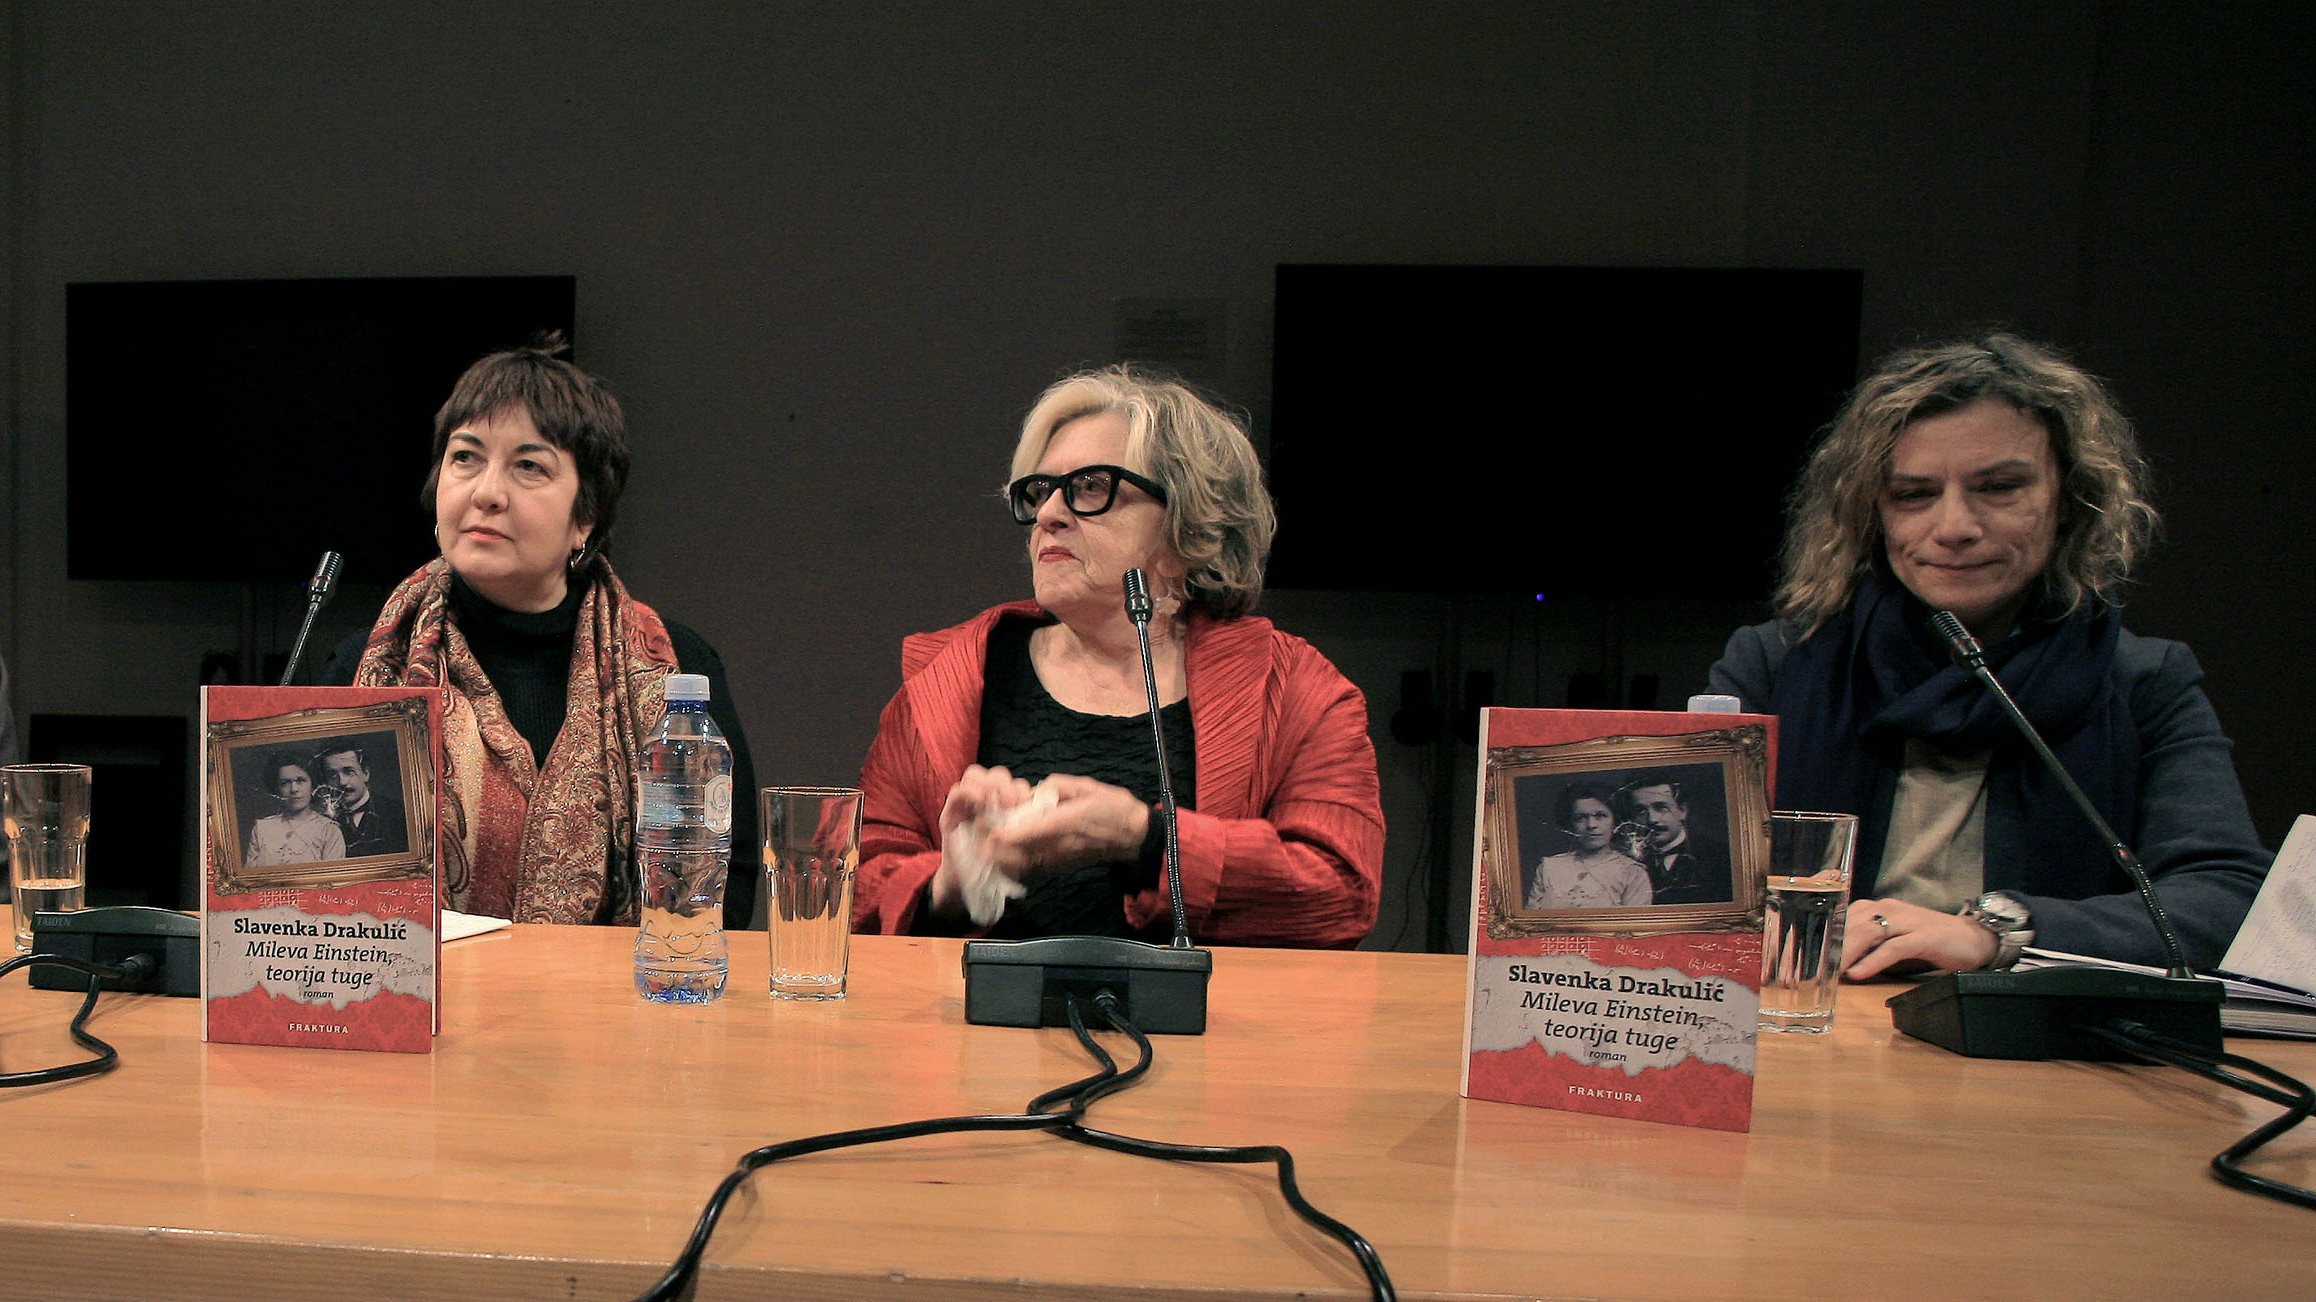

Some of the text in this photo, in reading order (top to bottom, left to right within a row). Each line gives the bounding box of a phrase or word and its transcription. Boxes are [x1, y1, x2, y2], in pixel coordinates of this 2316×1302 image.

[234, 918, 407, 940] Slavenka Drakulić
[245, 941, 393, 965] Mileva Einstein,
[266, 964, 373, 989] teorija tuge
[1508, 965, 1724, 1003] Slavenka Drakulić
[303, 990, 334, 999] roman
[1520, 991, 1705, 1029] Mileva Einstein,
[289, 1023, 349, 1034] FRAKTURA
[1544, 1019, 1679, 1054] teorija tuge
[1589, 1050, 1627, 1062] roman
[1568, 1085, 1643, 1103] FRAKTURA
